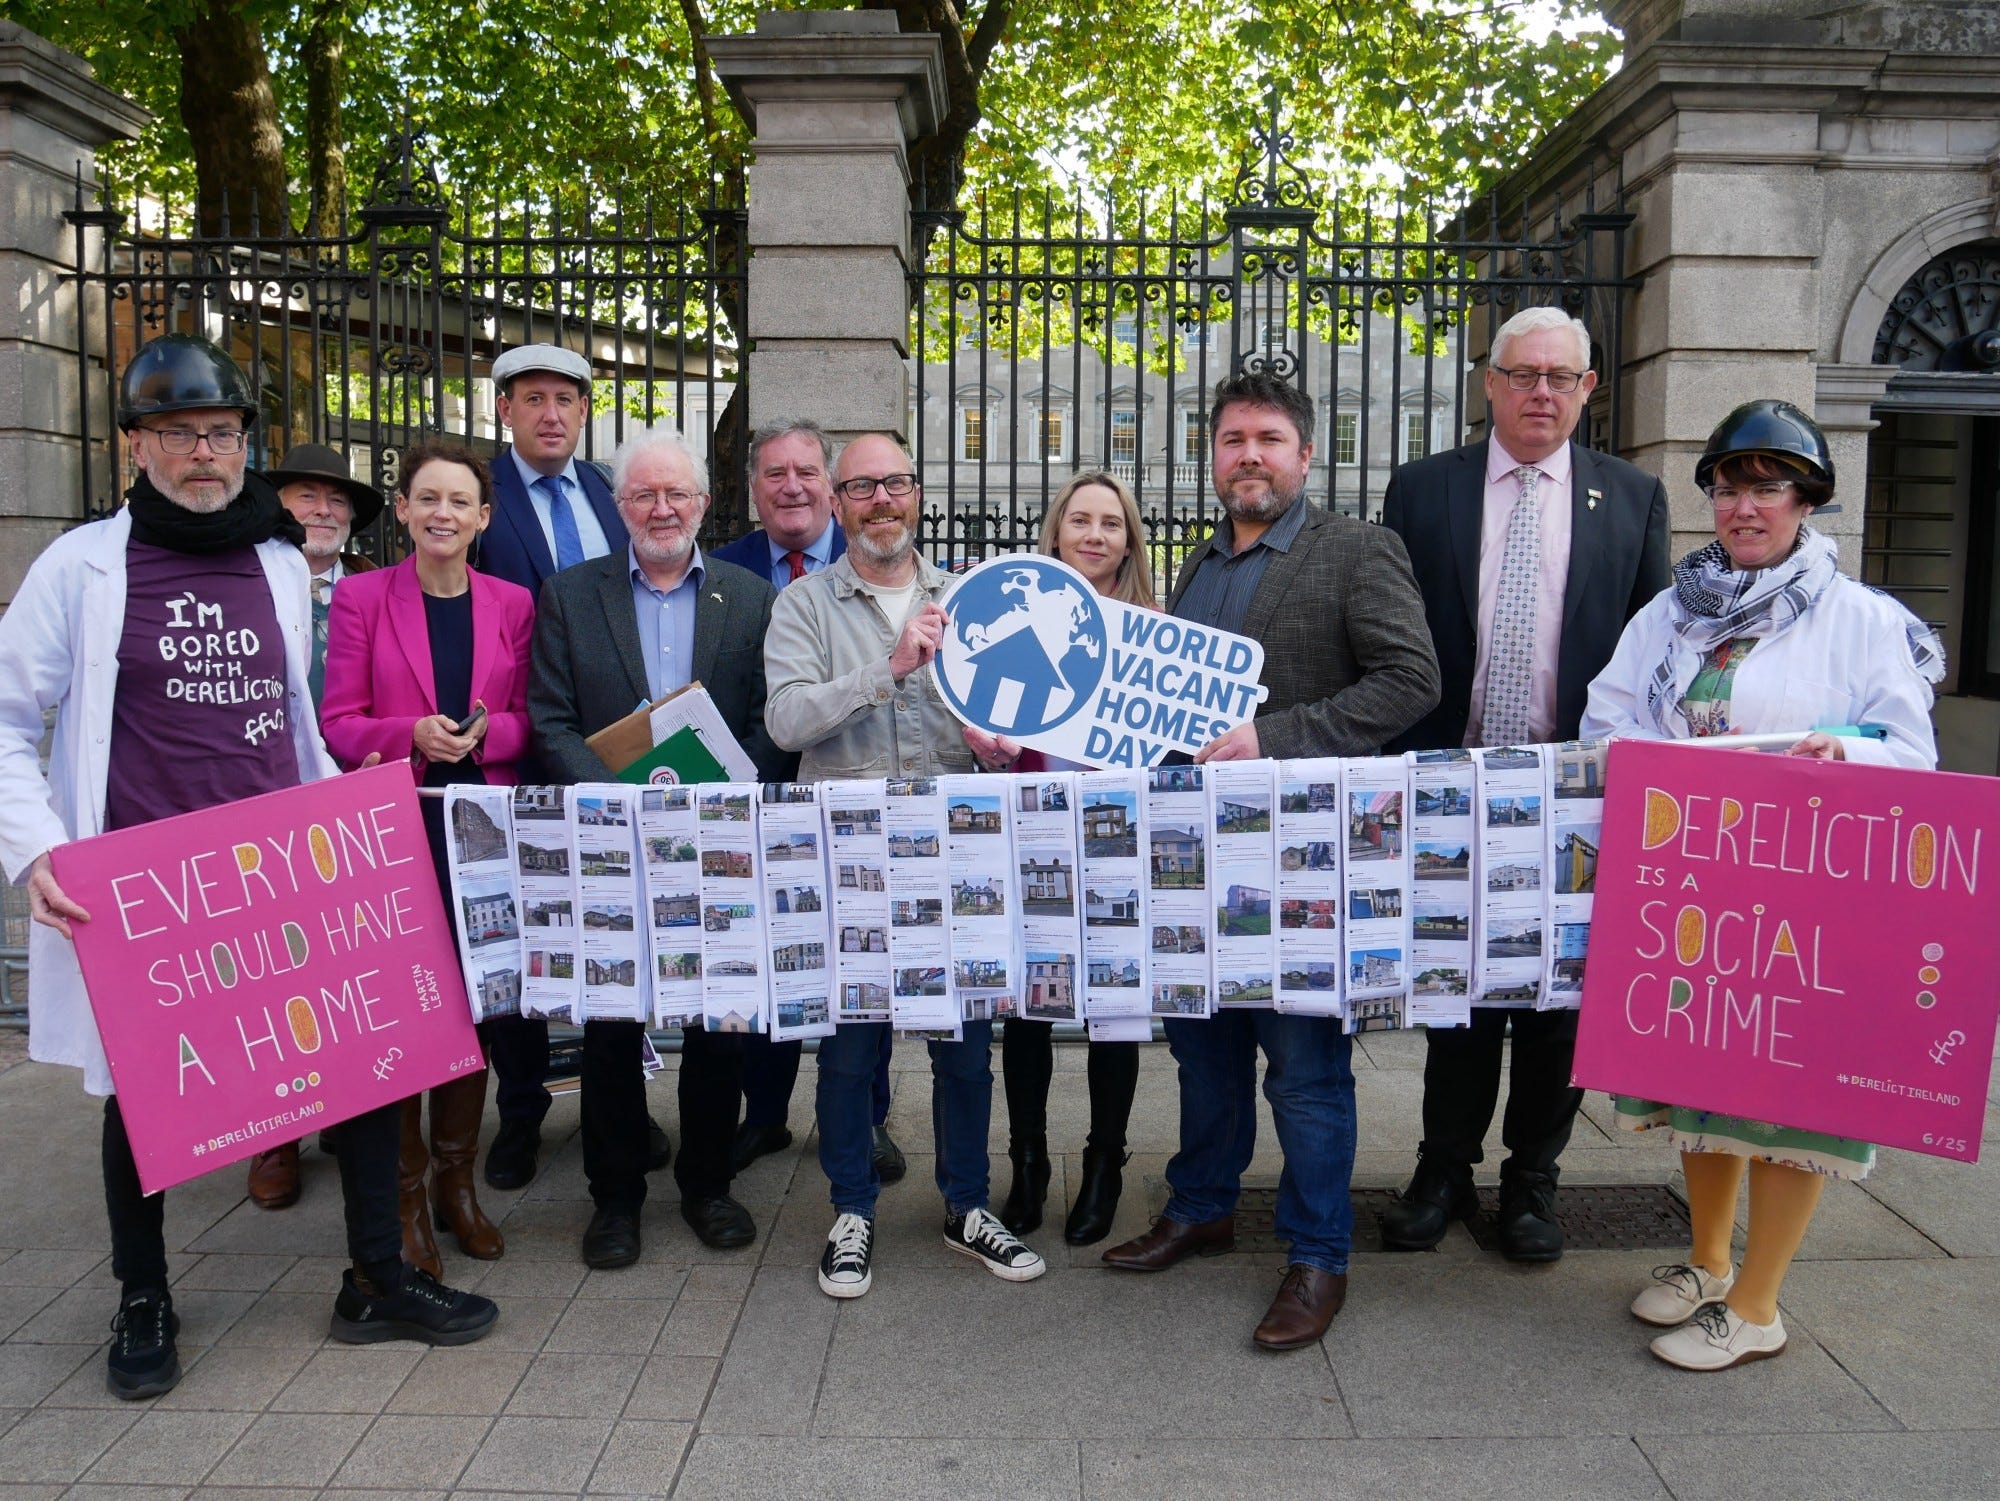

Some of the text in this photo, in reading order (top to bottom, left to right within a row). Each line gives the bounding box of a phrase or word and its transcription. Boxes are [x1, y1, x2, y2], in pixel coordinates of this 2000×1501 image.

[166, 592, 223, 629] I'M
[159, 628, 260, 661] BORED
[1121, 610, 1253, 675] WORLD
[1112, 648, 1258, 719] VACANT
[1095, 687, 1231, 748] HOMES
[1084, 725, 1163, 768] DAY
[111, 803, 414, 941] EVERYONE
[1635, 865, 1699, 892] IS A
[148, 887, 424, 1007] SHOULD HAVE
[411, 964, 431, 1012] MARTIN
[424, 969, 442, 1009] LEAHY
[179, 969, 399, 1096] A HOME
[449, 1055, 477, 1072] 6/25
[1922, 1133, 1967, 1152] 6/25
